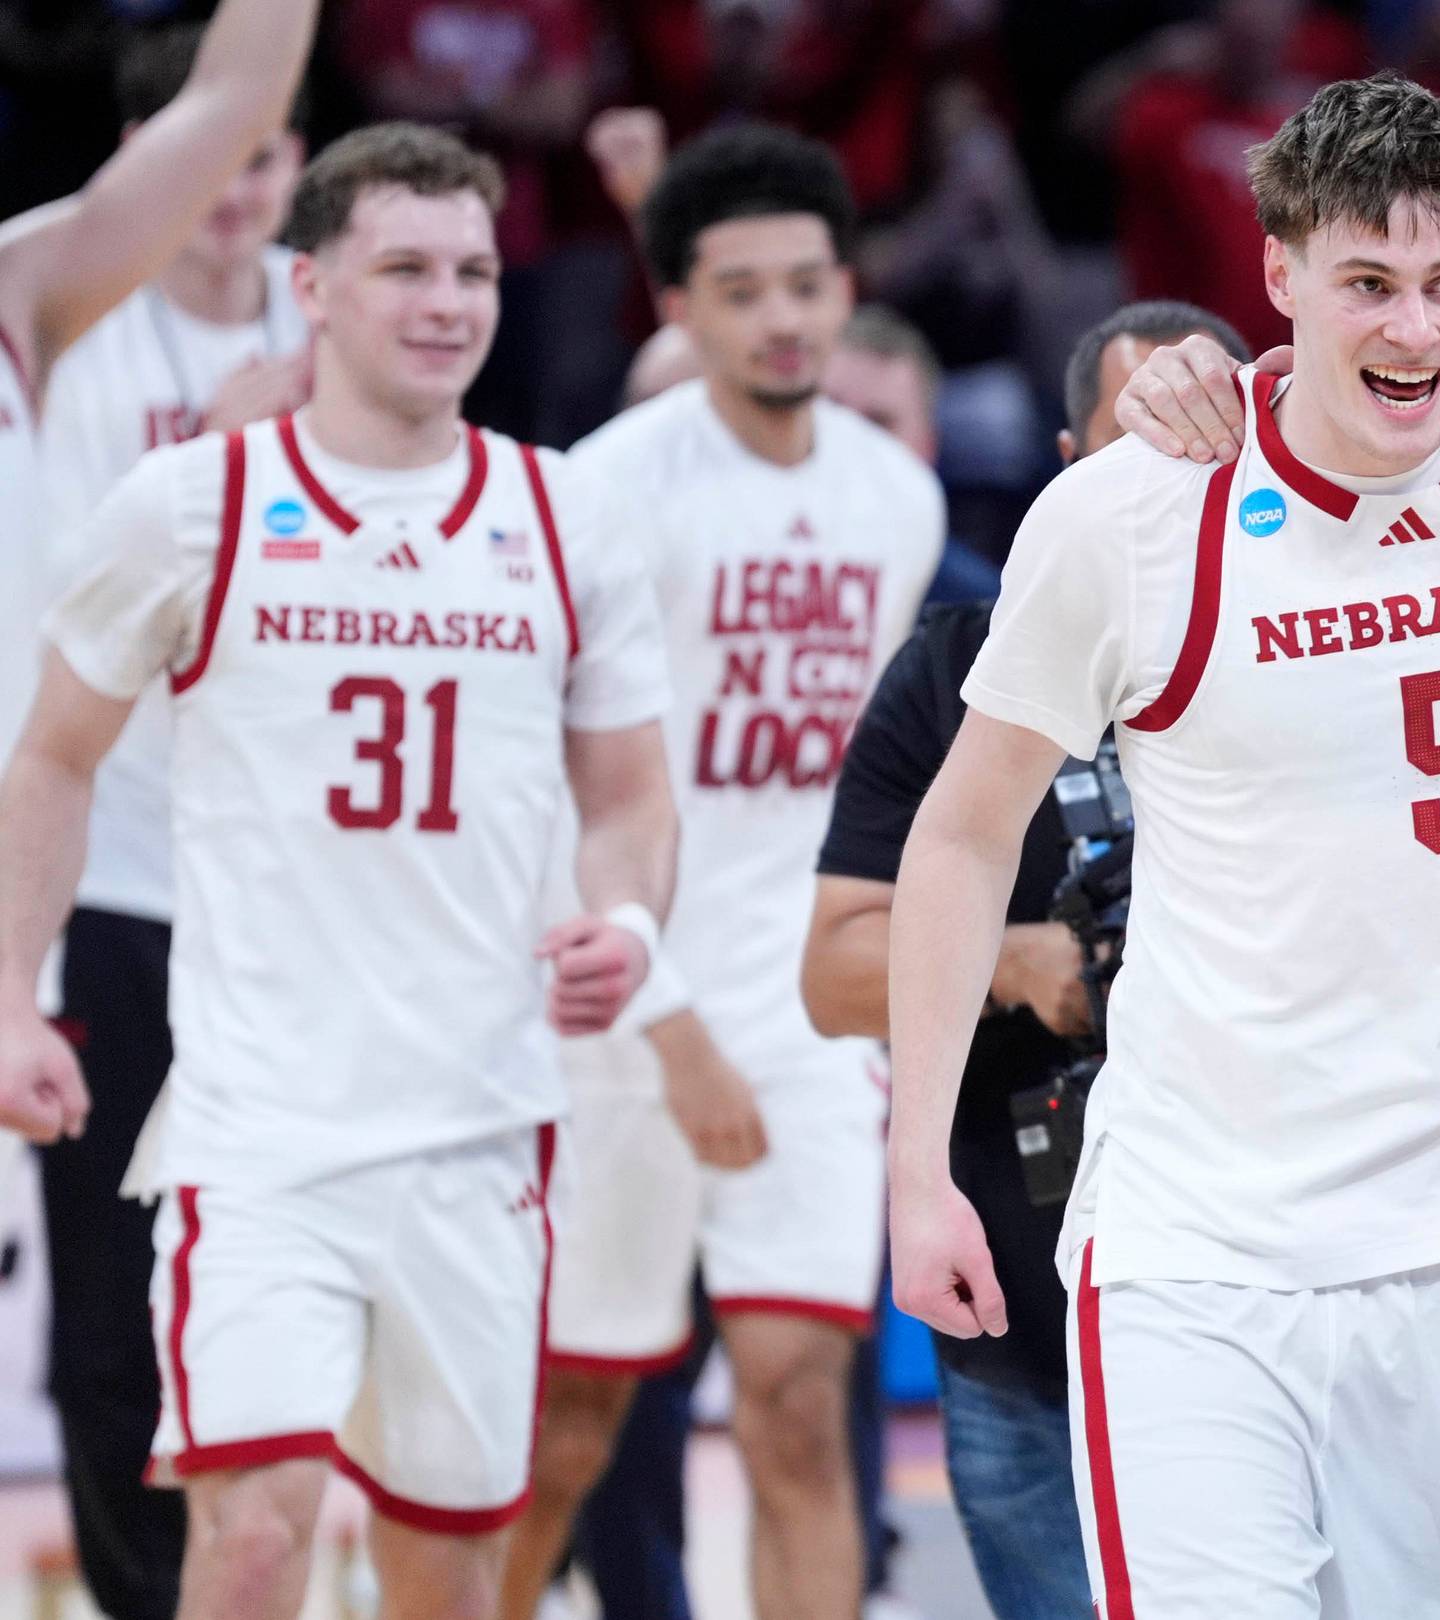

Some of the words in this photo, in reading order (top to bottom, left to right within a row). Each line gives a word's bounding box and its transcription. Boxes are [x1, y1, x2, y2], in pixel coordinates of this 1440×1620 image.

[1245, 508, 1283, 526] NCAA
[254, 605, 537, 654] NEBRASKA
[720, 651, 765, 696] N
[327, 674, 459, 832] 31
